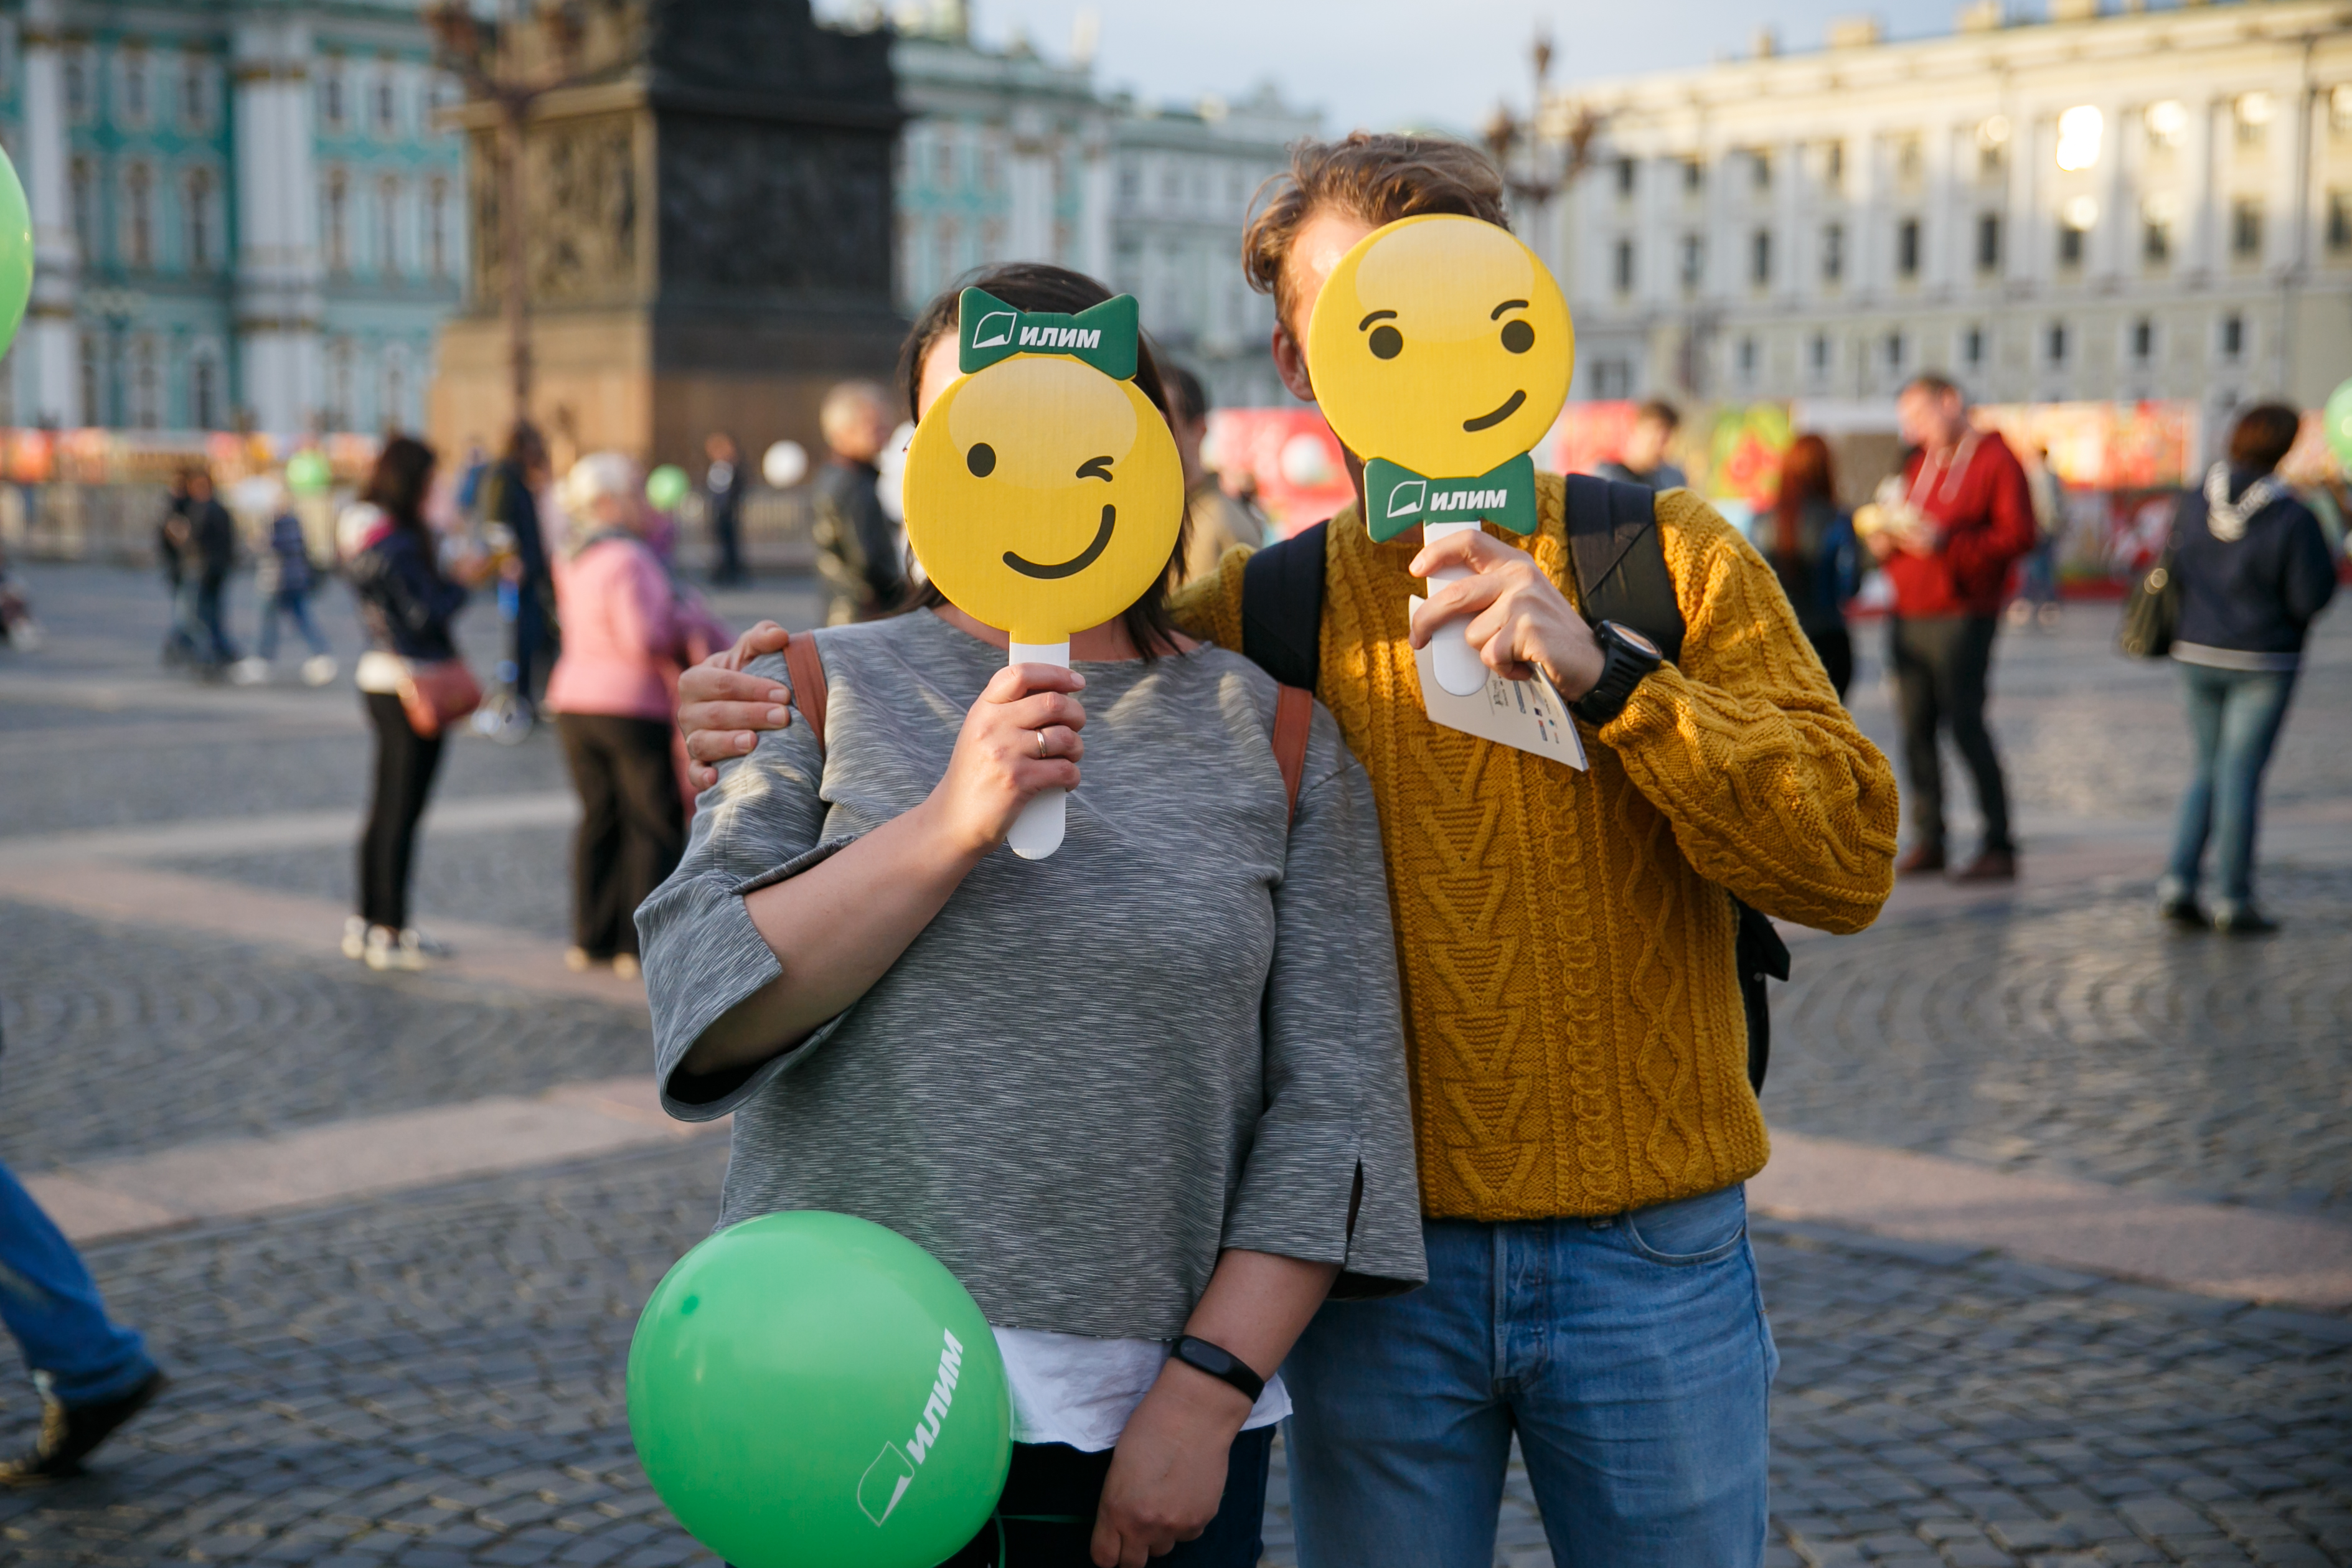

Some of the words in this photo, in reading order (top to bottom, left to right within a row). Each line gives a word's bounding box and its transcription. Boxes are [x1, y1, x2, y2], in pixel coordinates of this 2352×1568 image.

[1019, 326, 1101, 349] ИЛИМ
[1430, 489, 1507, 511] ИЛИМ
[906, 1326, 963, 1465] ИЛИМ
